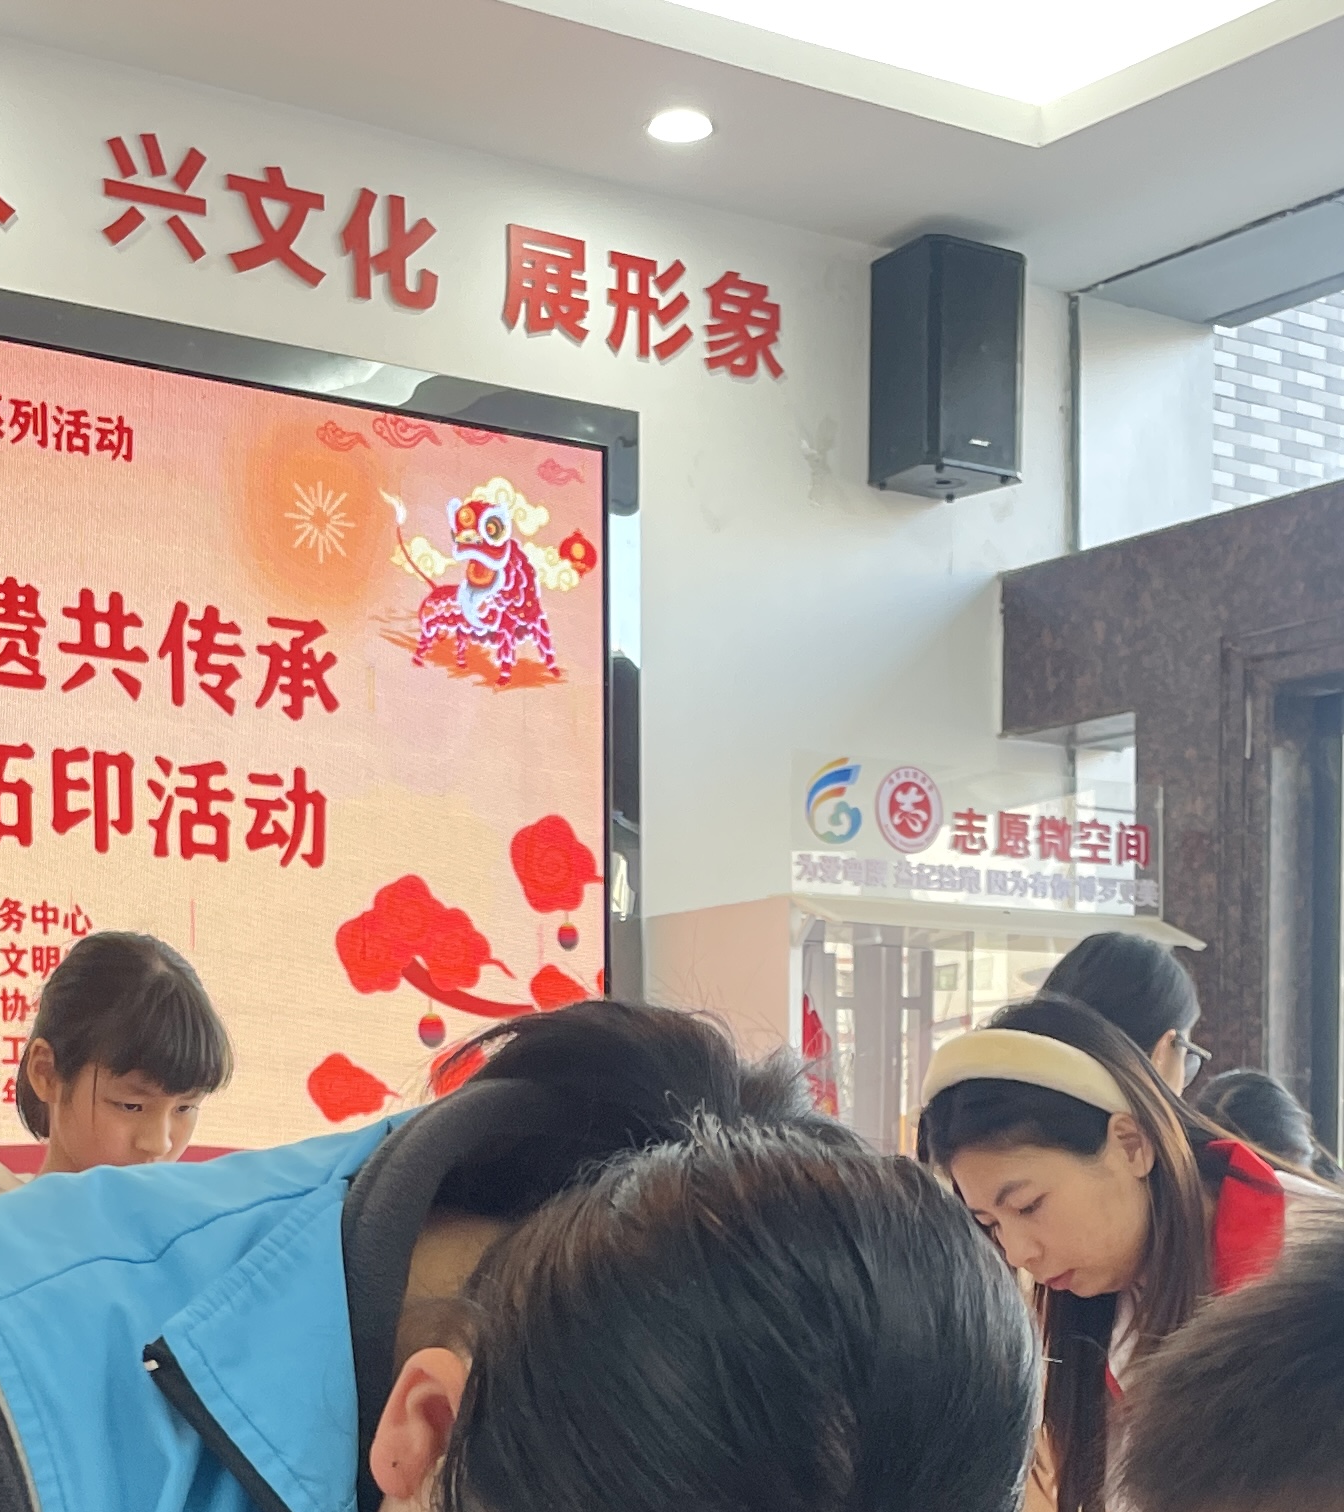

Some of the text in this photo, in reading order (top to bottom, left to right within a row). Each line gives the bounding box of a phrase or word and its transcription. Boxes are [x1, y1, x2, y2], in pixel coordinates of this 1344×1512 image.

[102, 133, 439, 311] 兴文化
[503, 224, 784, 379] 展形象
[950, 807, 1151, 869] 志愿微空间
